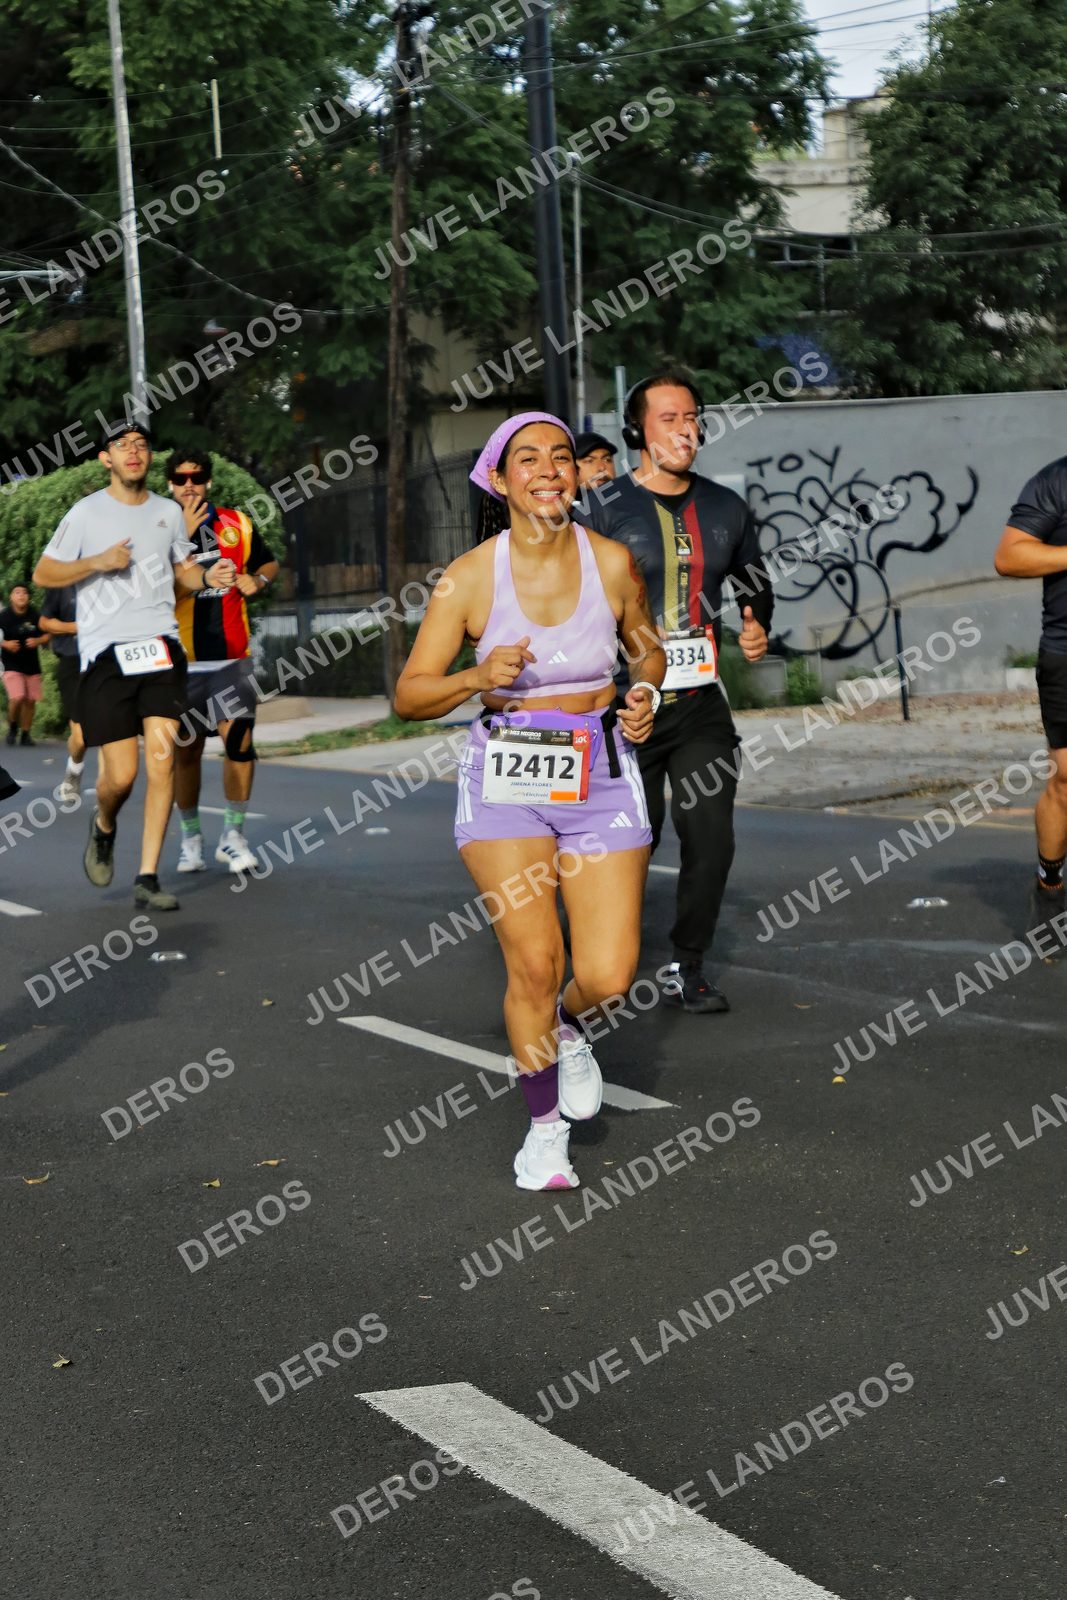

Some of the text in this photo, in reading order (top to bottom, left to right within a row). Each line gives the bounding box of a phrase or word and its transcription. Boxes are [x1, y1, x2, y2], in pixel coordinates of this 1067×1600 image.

[747, 445, 841, 483] TOY
[124, 643, 158, 661] 8510
[491, 752, 575, 780] 12412
